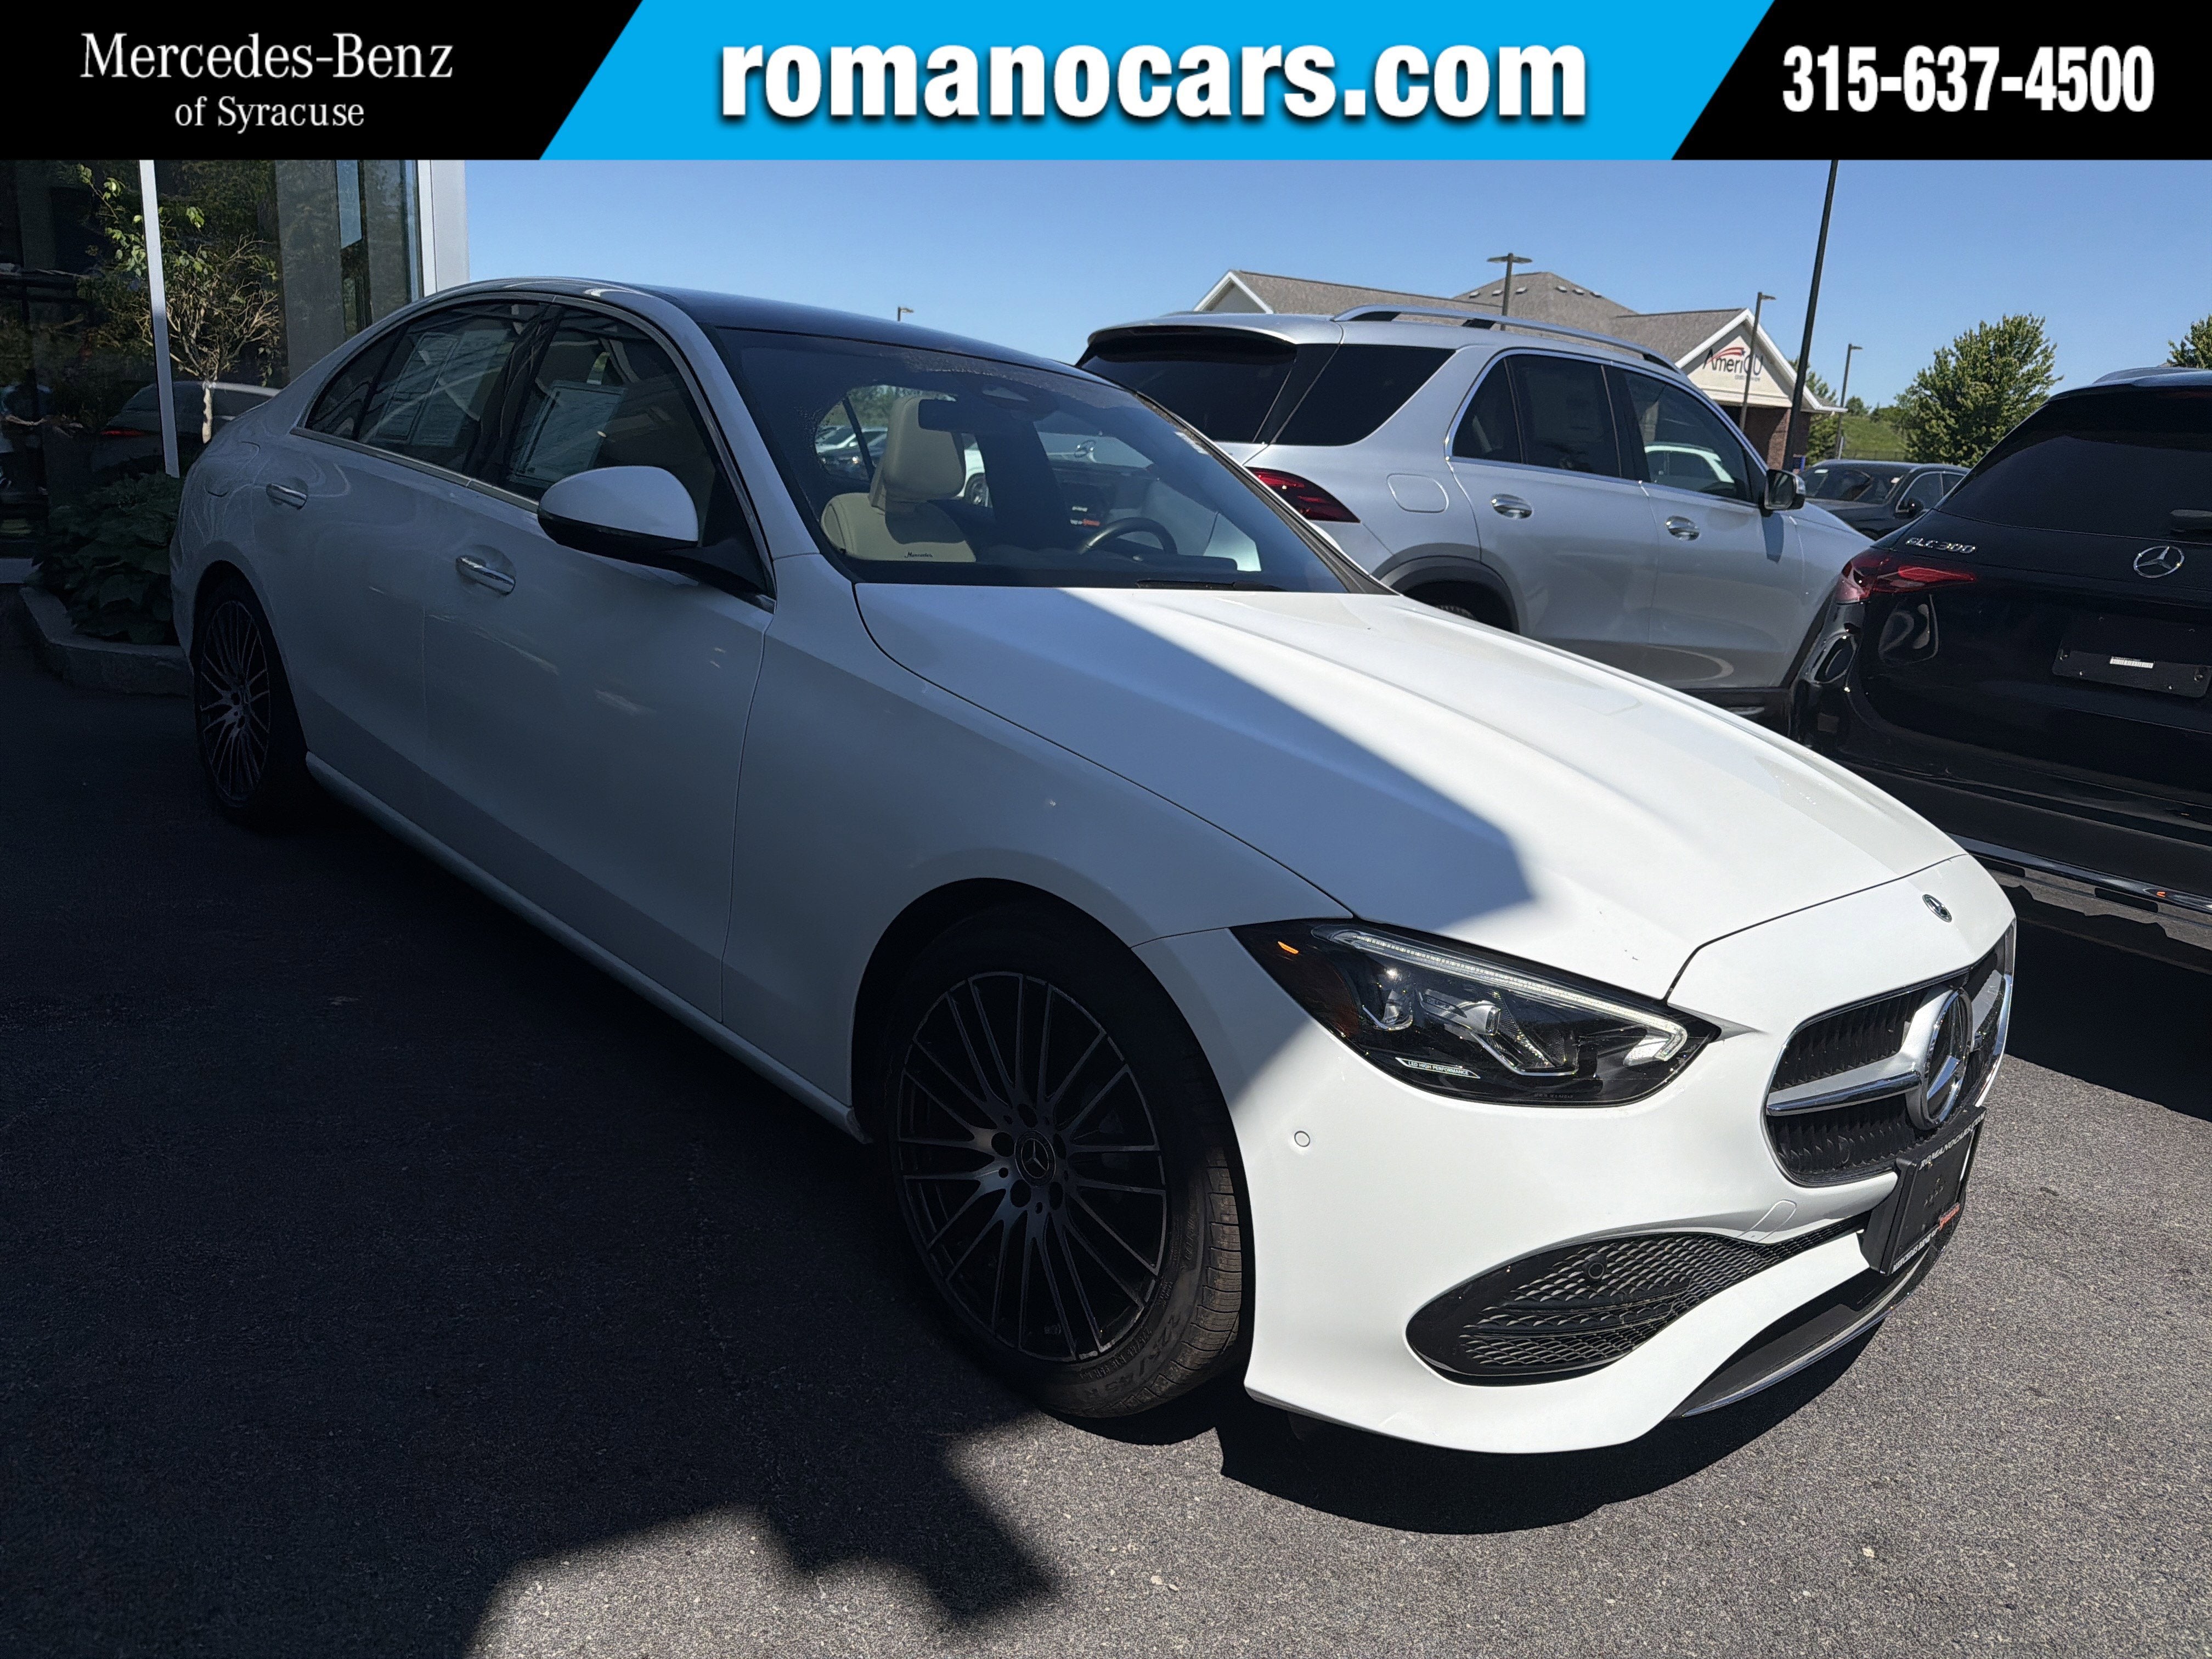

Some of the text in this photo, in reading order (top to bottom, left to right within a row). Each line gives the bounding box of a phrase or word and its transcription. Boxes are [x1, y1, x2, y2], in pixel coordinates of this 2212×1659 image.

[1905, 537, 1977, 554] GLC 300
[1432, 1065, 1469, 1076] PERFORMANCE
